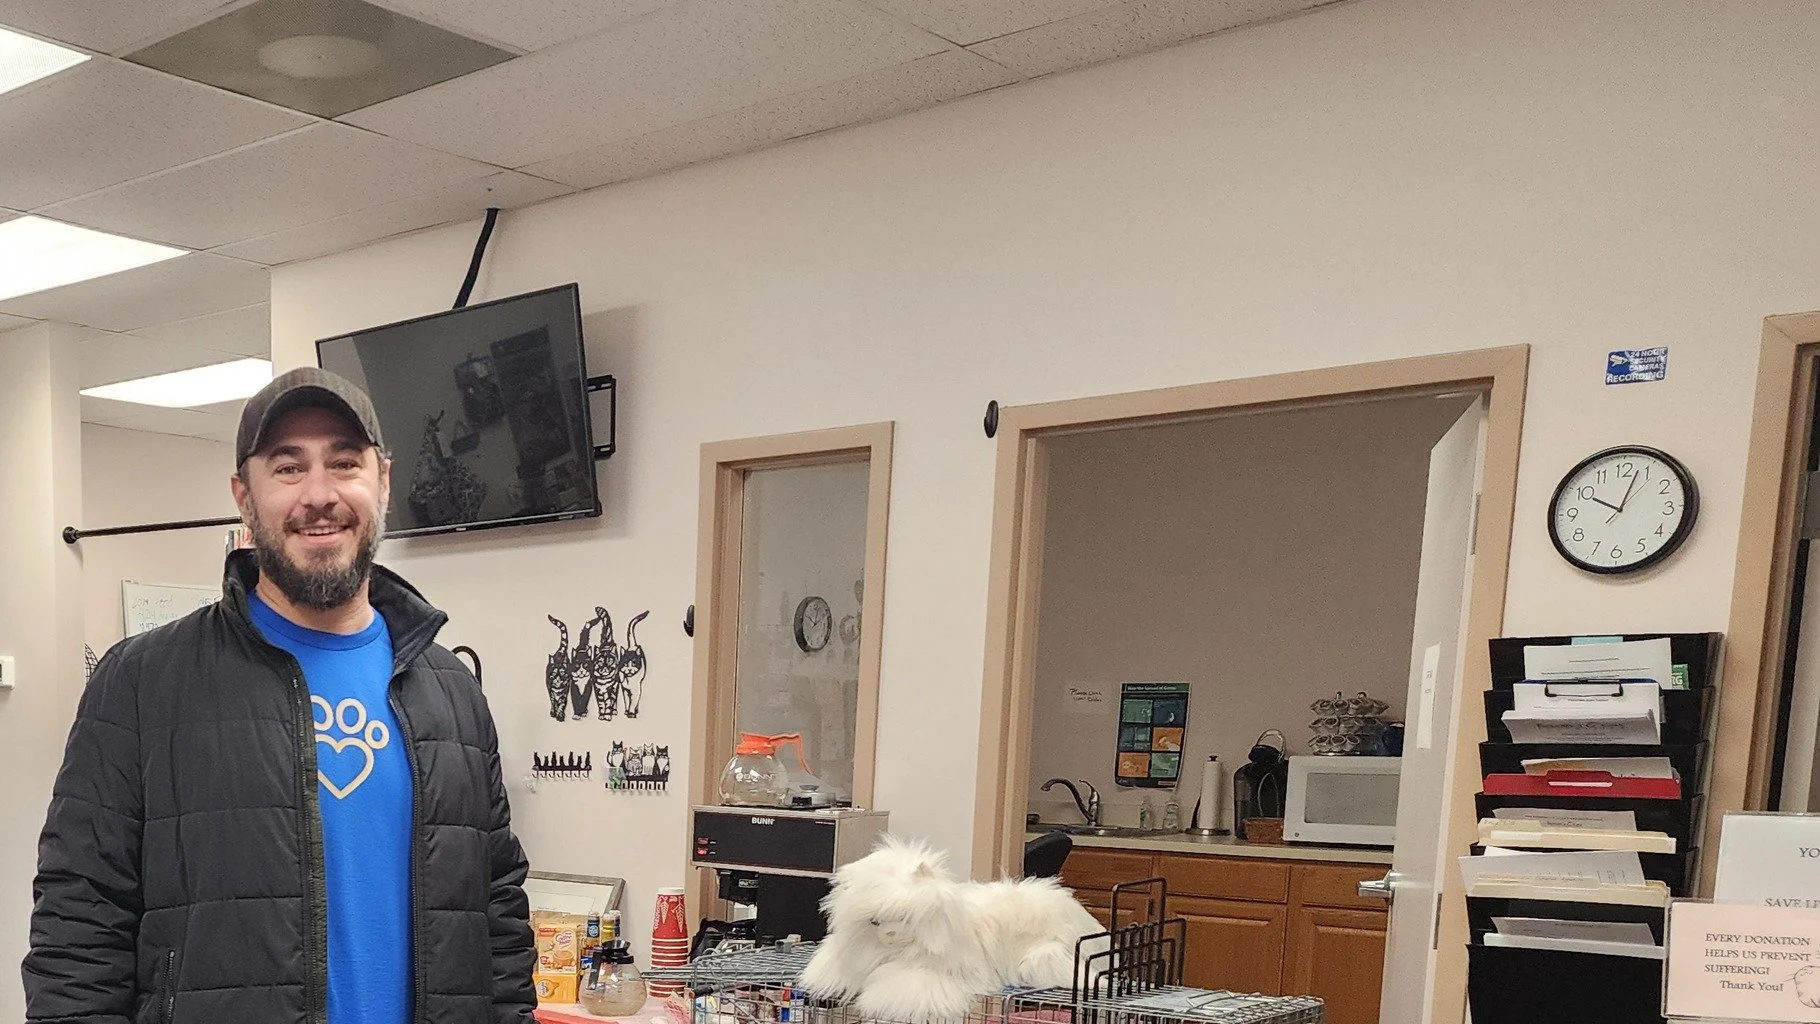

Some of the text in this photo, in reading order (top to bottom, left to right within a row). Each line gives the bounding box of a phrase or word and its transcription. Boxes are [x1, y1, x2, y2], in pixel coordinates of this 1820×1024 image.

[1606, 370, 1664, 383] RECORDING
[1596, 469, 1608, 485] 11
[1615, 462, 1634, 479] 12
[1644, 466, 1651, 481] 1
[1576, 485, 1596, 502] 10
[1658, 479, 1672, 496] 2
[1566, 507, 1580, 523] 9
[1662, 500, 1675, 516] 3
[1572, 527, 1585, 542] 8
[1654, 523, 1665, 538] 4
[1591, 541, 1602, 556] 7
[1610, 544, 1623, 559] 6
[1635, 537, 1647, 554] 5
[751, 817, 775, 825] BUNN
[1764, 898, 1801, 908] SAVE
[1705, 933, 1811, 946] EVERY DONATION
[1705, 948, 1811, 962] HELPS US PREVENT
[1704, 964, 1770, 976] SUFFERING!
[1720, 980, 1784, 992] Thank You!
